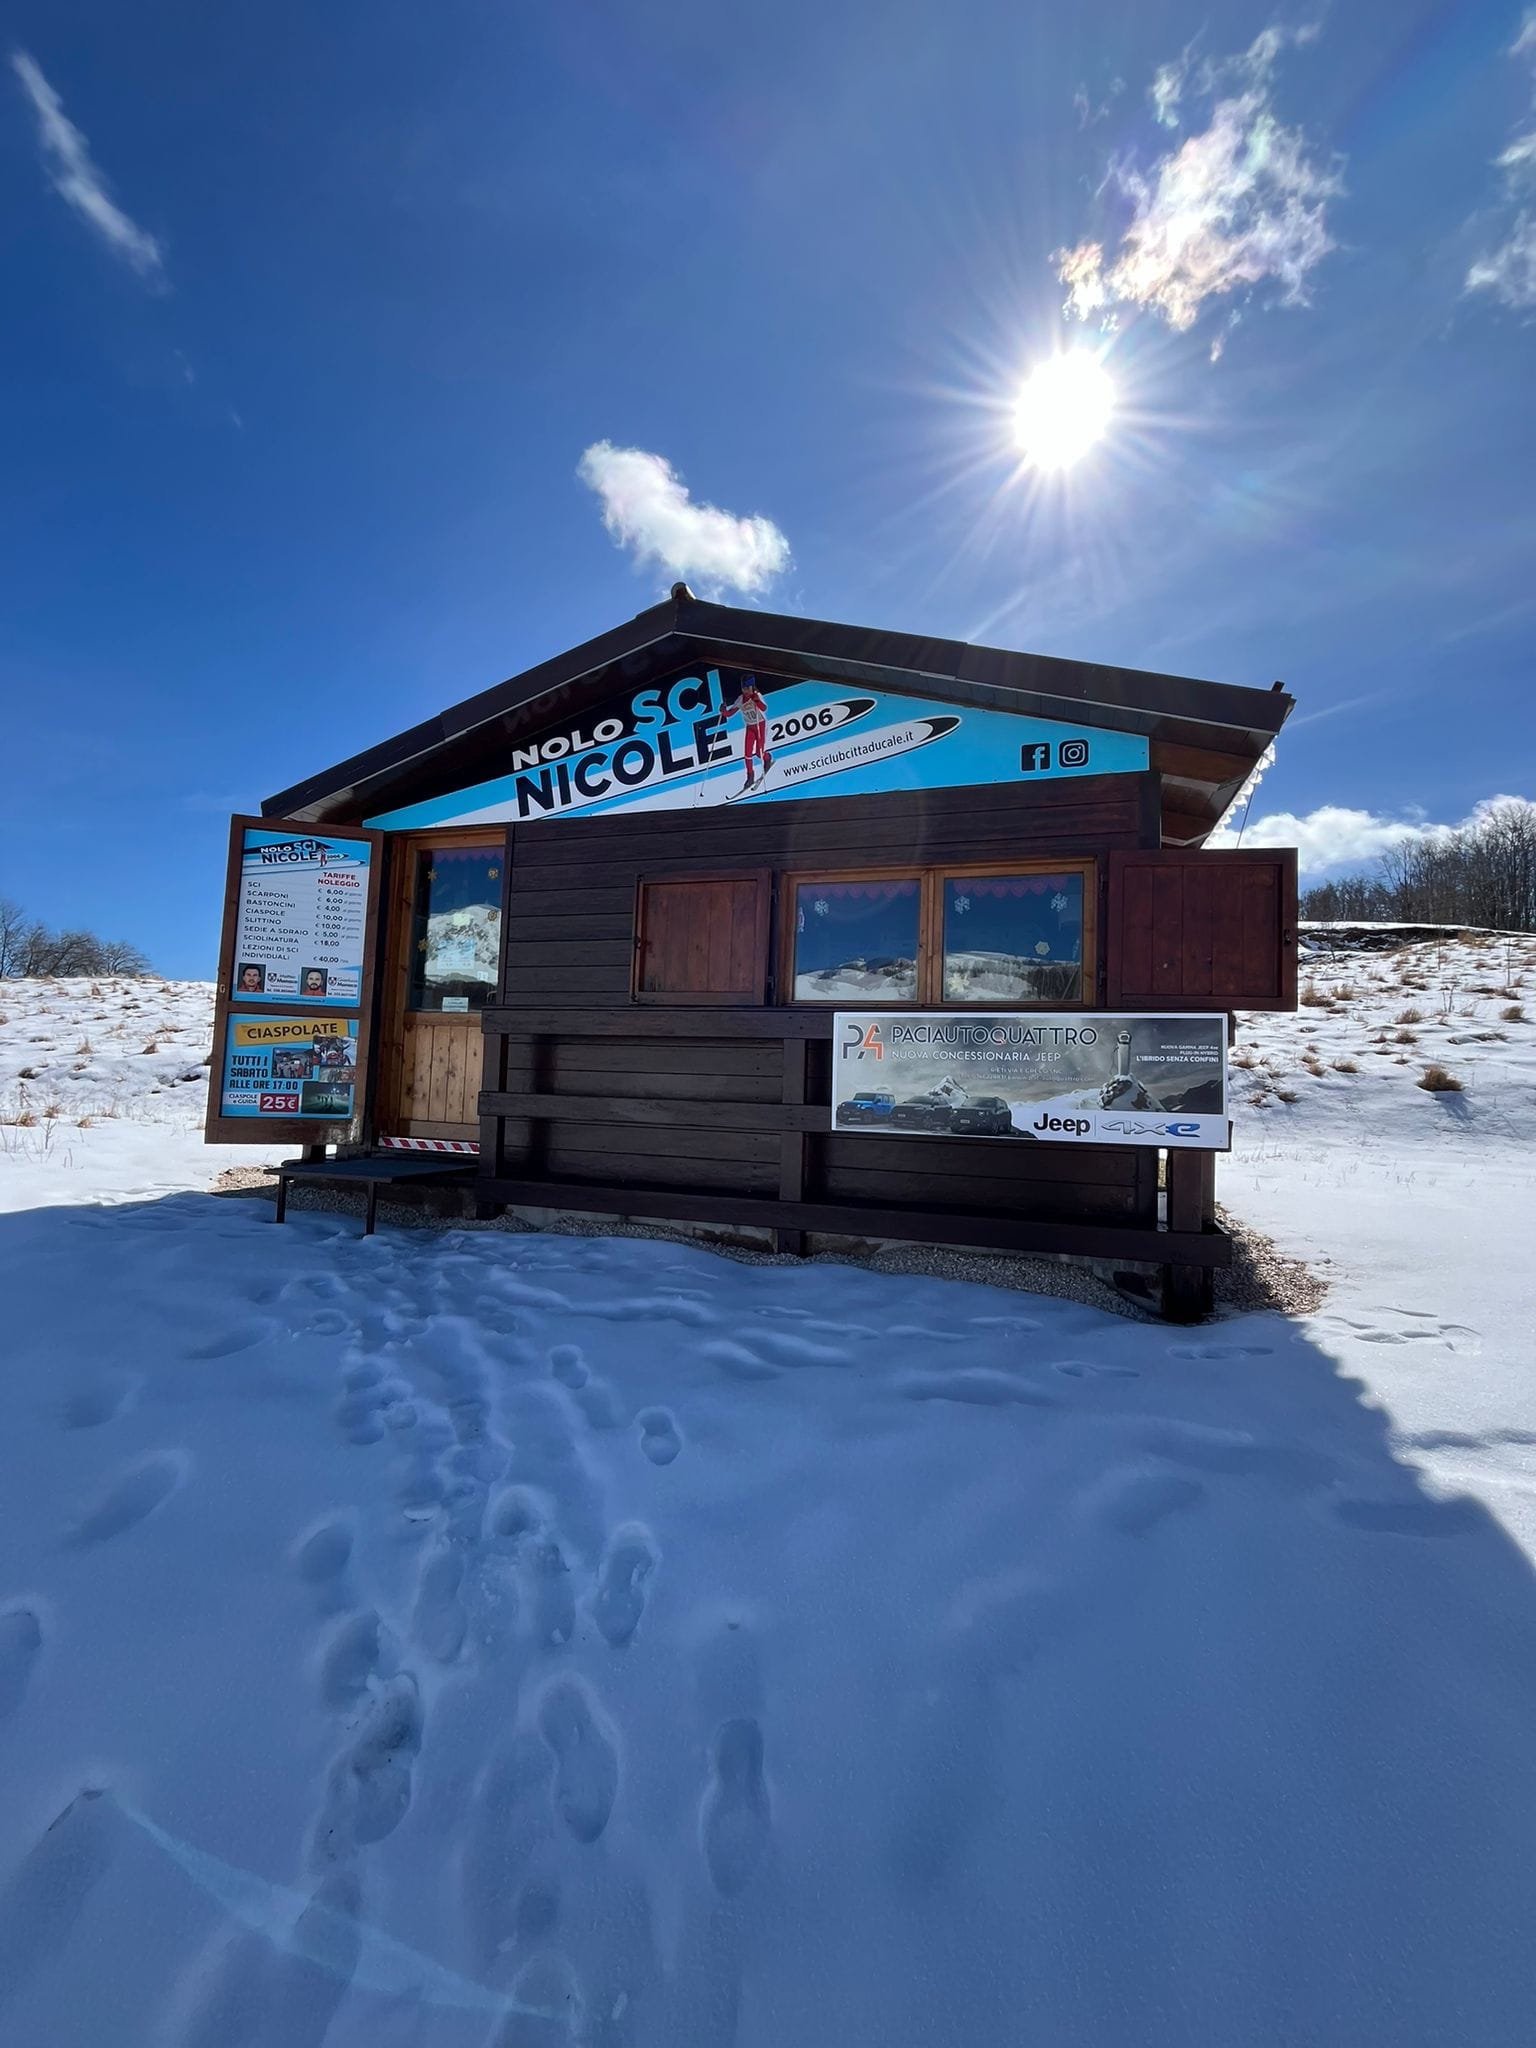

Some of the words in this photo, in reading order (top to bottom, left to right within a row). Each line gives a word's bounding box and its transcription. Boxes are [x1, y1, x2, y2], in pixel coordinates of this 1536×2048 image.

[512, 719, 624, 771] NOLO
[631, 669, 724, 733] SCI
[771, 708, 833, 742] 2006
[783, 731, 914, 777] www.sciclubcittaducale.it
[515, 715, 733, 817] NICOLE
[294, 841, 317, 852] SCI
[262, 851, 318, 864] NICOLE
[323, 872, 356, 880] TARIFFE
[318, 879, 360, 888] NOLEGGIO
[248, 891, 288, 899] SCARPONI
[247, 899, 295, 908] BASTONCINI
[246, 908, 286, 916] CIASPOLE
[245, 917, 281, 925] SLITTINO
[244, 935, 299, 943] SCIOLINATURA
[242, 952, 290, 960] INDIVIDUALI
[247, 1023, 338, 1039] CIASPOLATE
[892, 1026, 1098, 1045] PACIAUTOQUATTRO
[232, 1055, 261, 1066] TUTTI
[264, 1056, 268, 1066] I
[892, 1051, 928, 1059] NUOVA
[933, 1051, 1030, 1061] CONCESSIONARIA
[1035, 1052, 1061, 1062] JEEP
[231, 1068, 268, 1078] SABATO
[229, 1080, 250, 1089] ALLE
[253, 1081, 270, 1090] ORE
[273, 1081, 298, 1090] 17:00
[1034, 1113, 1090, 1136] Jeep
